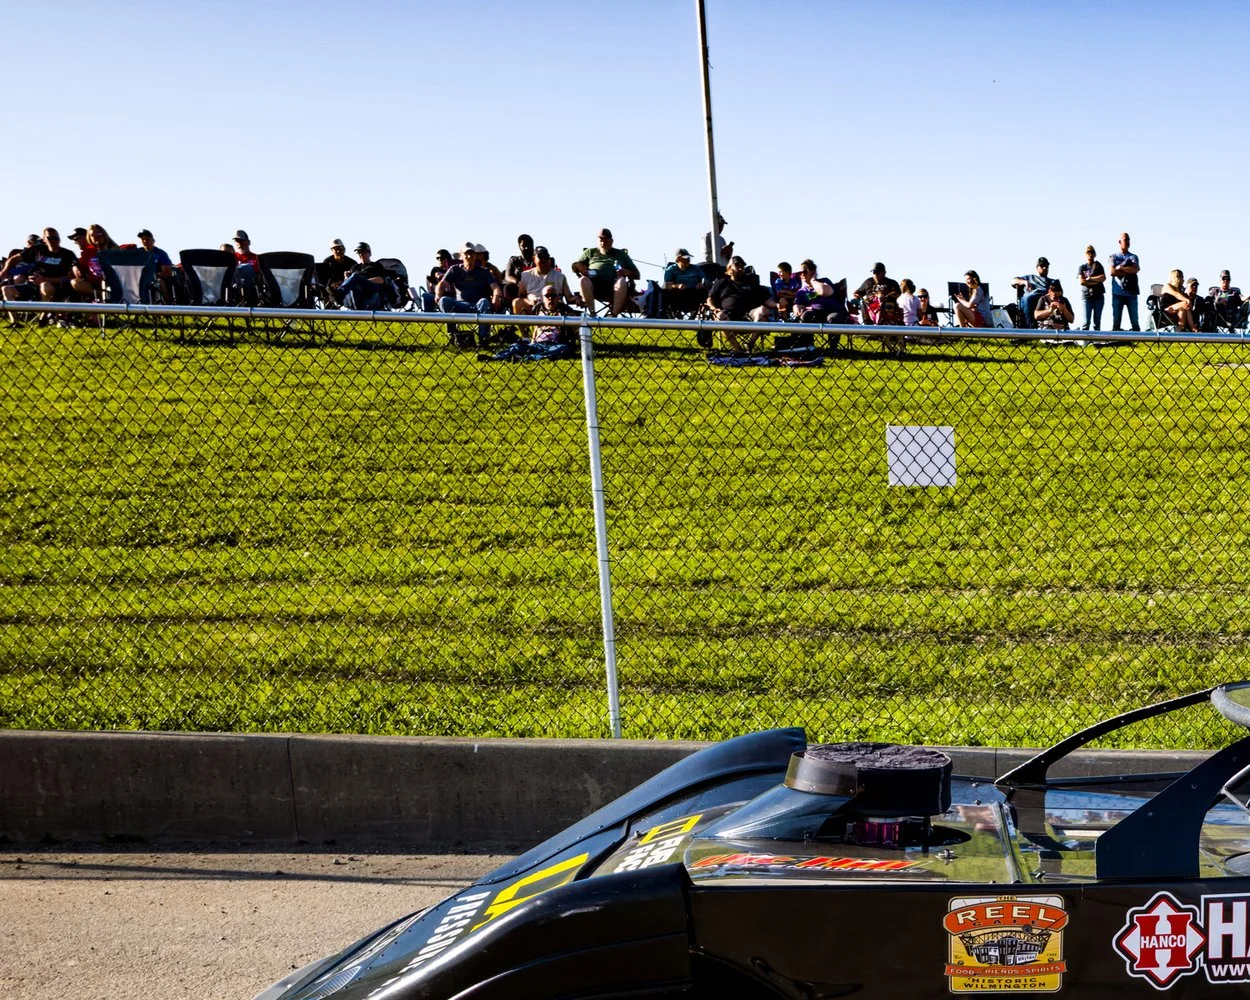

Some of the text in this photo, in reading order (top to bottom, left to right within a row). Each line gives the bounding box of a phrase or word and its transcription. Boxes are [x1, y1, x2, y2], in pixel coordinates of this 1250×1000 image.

[956, 905, 1056, 924] REEL
[1140, 934, 1186, 949] HANCO
[1026, 965, 1061, 973] SPIRITS
